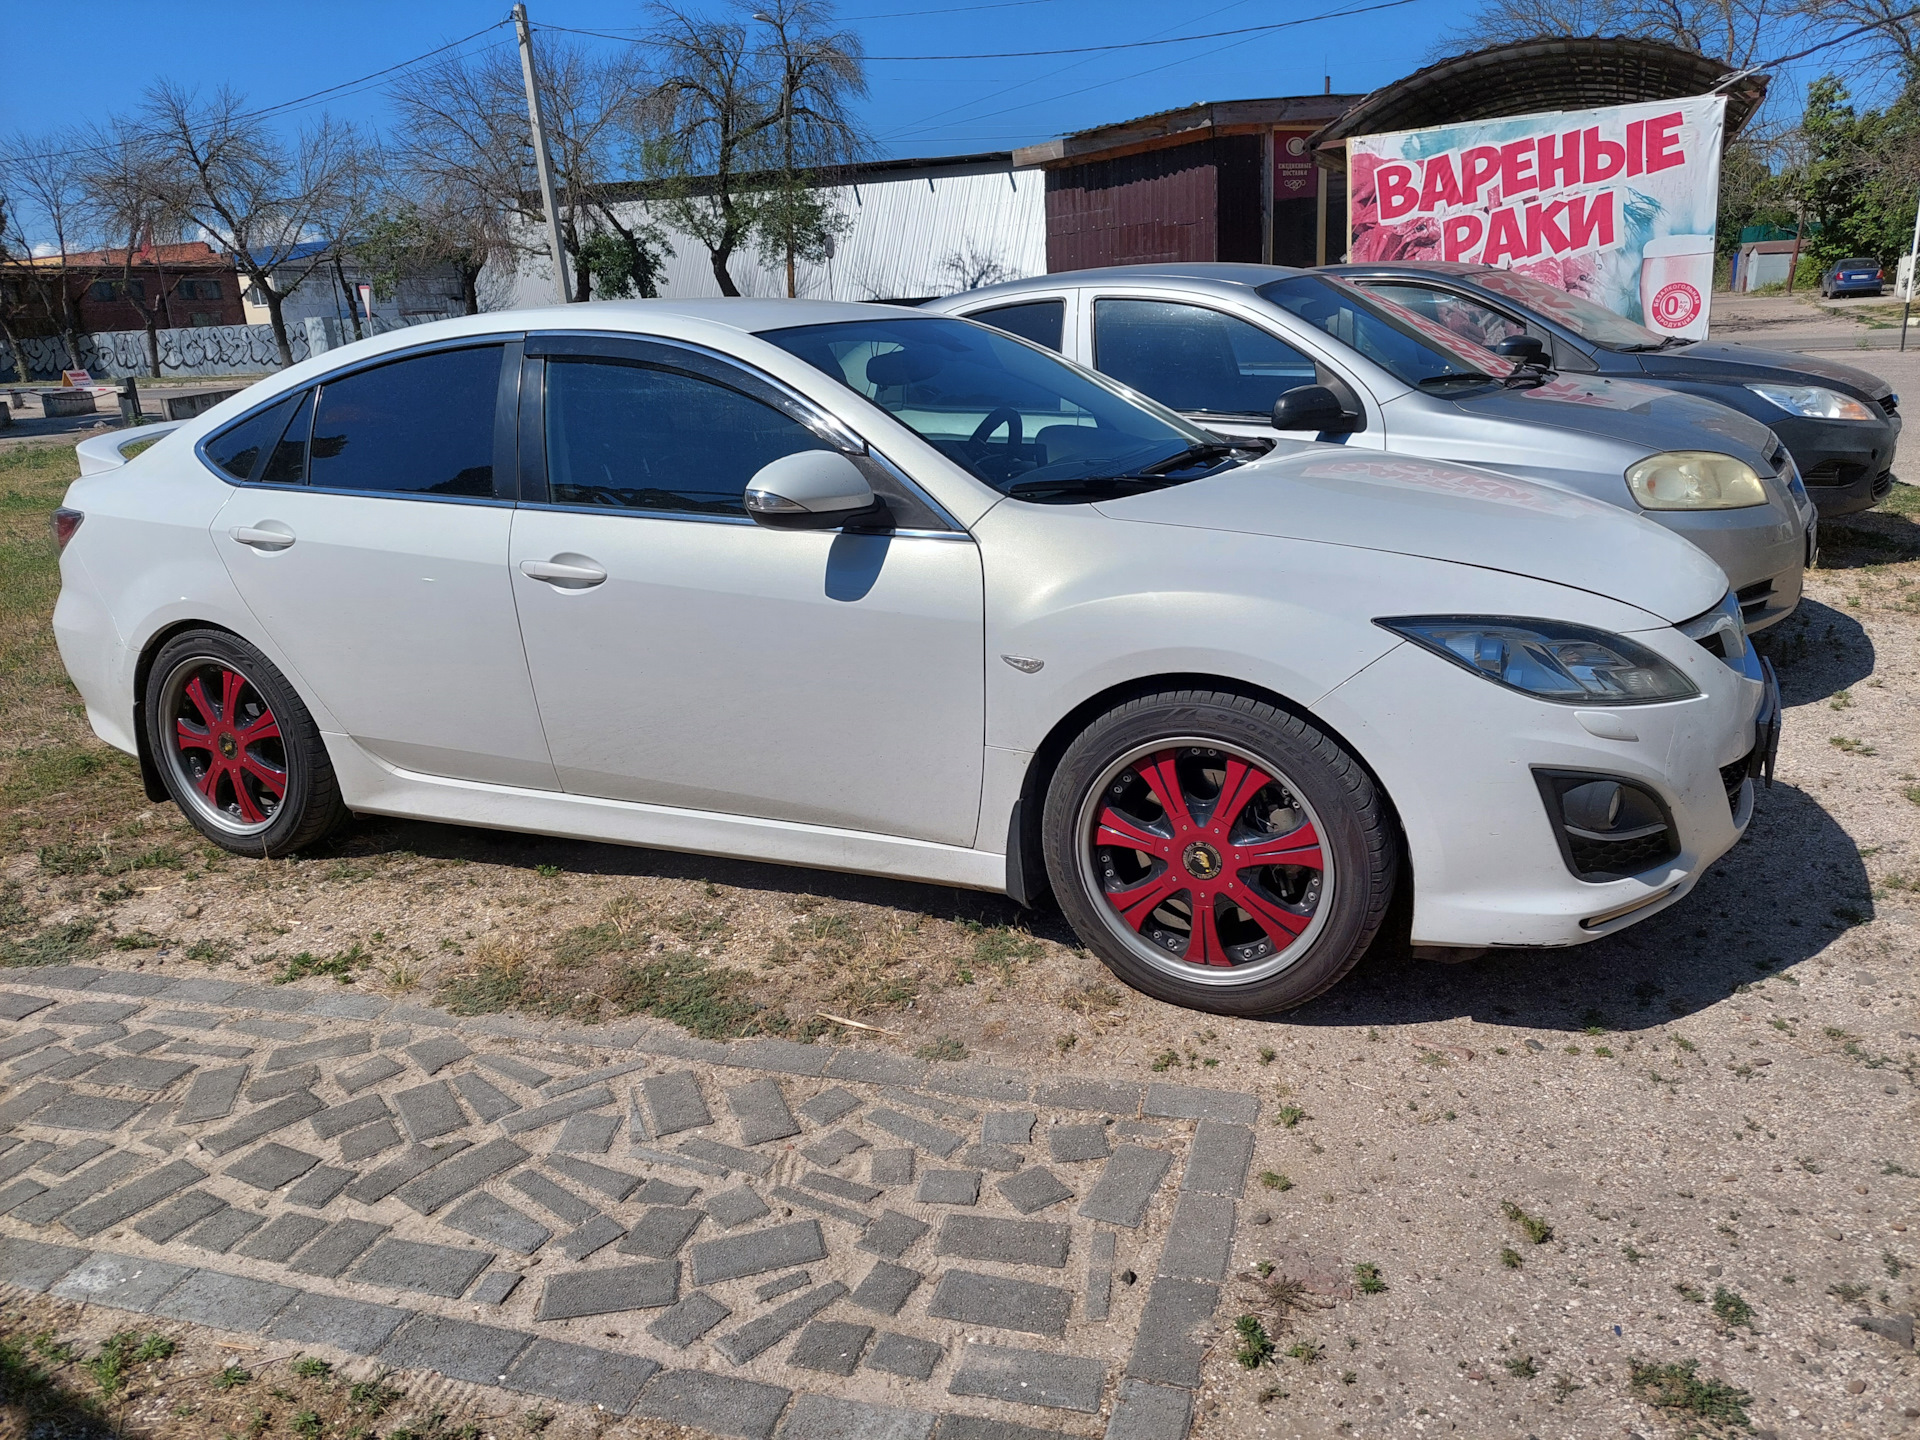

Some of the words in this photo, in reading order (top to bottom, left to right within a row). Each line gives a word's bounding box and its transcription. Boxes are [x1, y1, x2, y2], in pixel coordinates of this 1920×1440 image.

[1375, 111, 1686, 221] ВАРЕНЫЕ
[1442, 190, 1615, 265] РАКИ
[1653, 283, 1700, 307] БЕЗАЛКОГОЛЬНАЯ
[1655, 313, 1696, 328] ПРОДУКЦИЯ
[1215, 713, 1312, 769] SPORTEX
